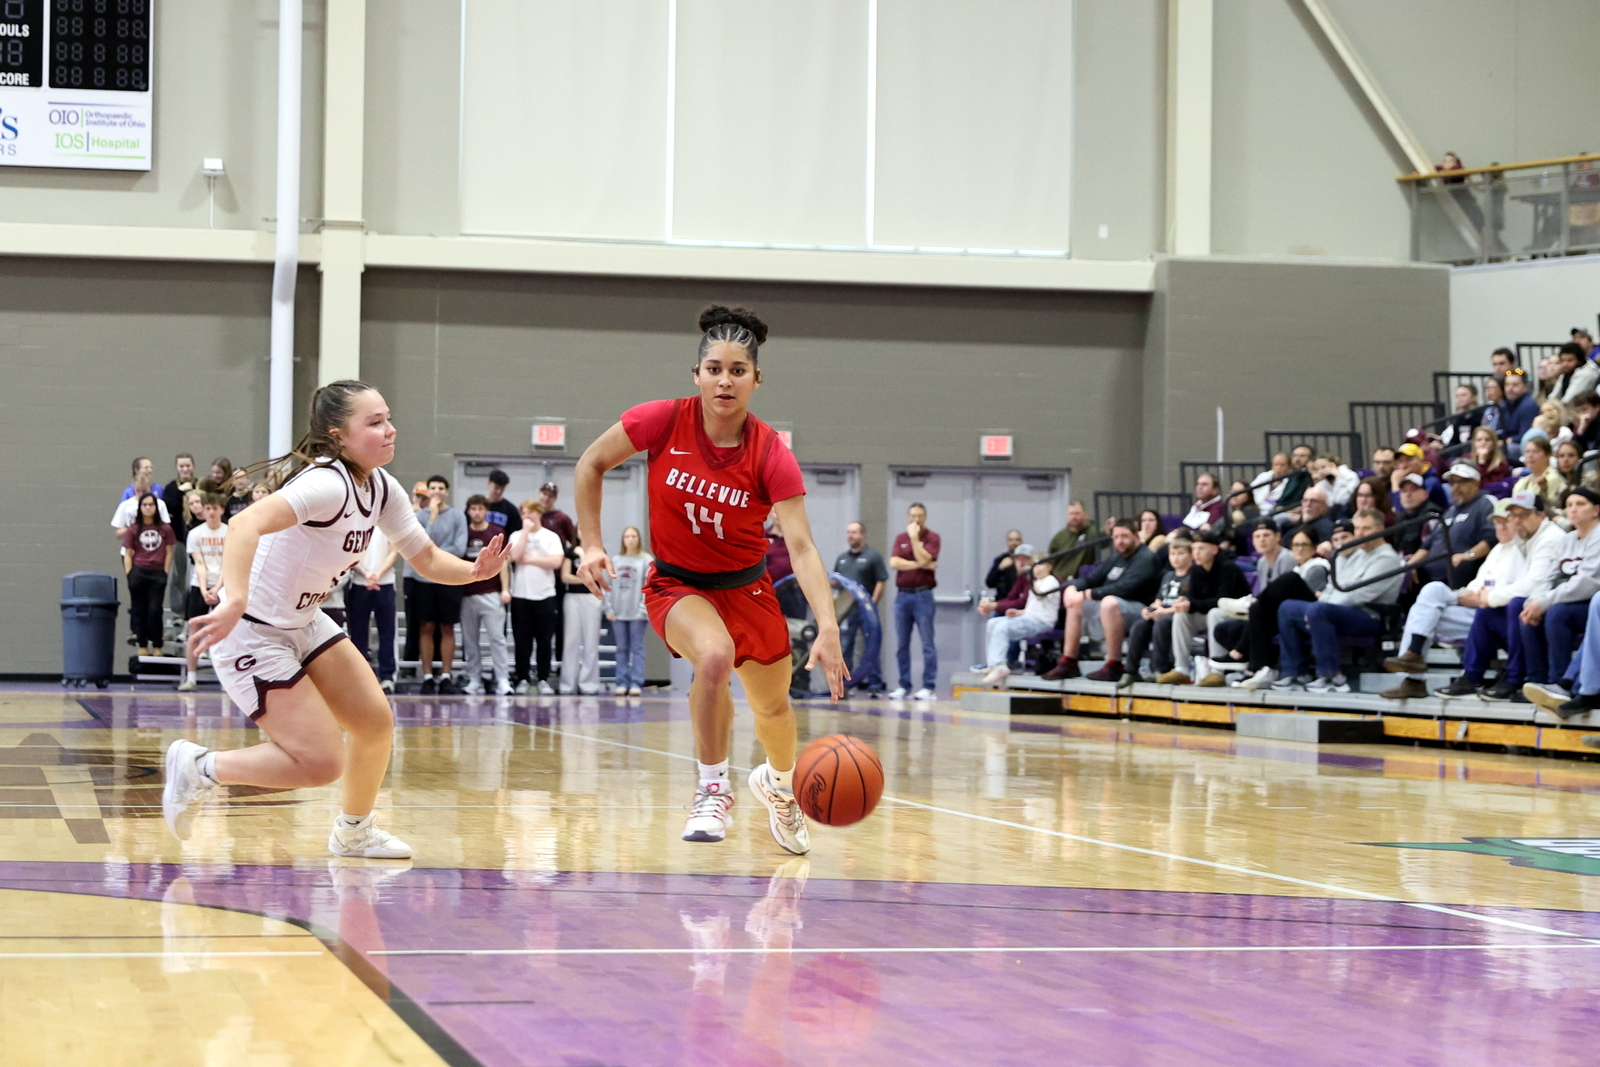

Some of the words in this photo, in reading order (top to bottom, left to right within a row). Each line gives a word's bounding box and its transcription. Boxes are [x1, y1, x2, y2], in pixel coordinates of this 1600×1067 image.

[49, 109, 80, 126] OIO
[85, 110, 134, 120] Orthopaedic
[85, 119, 118, 127] Institute
[54, 132, 84, 149] IOS
[91, 137, 140, 150] Hospital
[665, 467, 751, 508] BELLEVUE
[683, 502, 725, 540] 14
[234, 654, 257, 672] G
